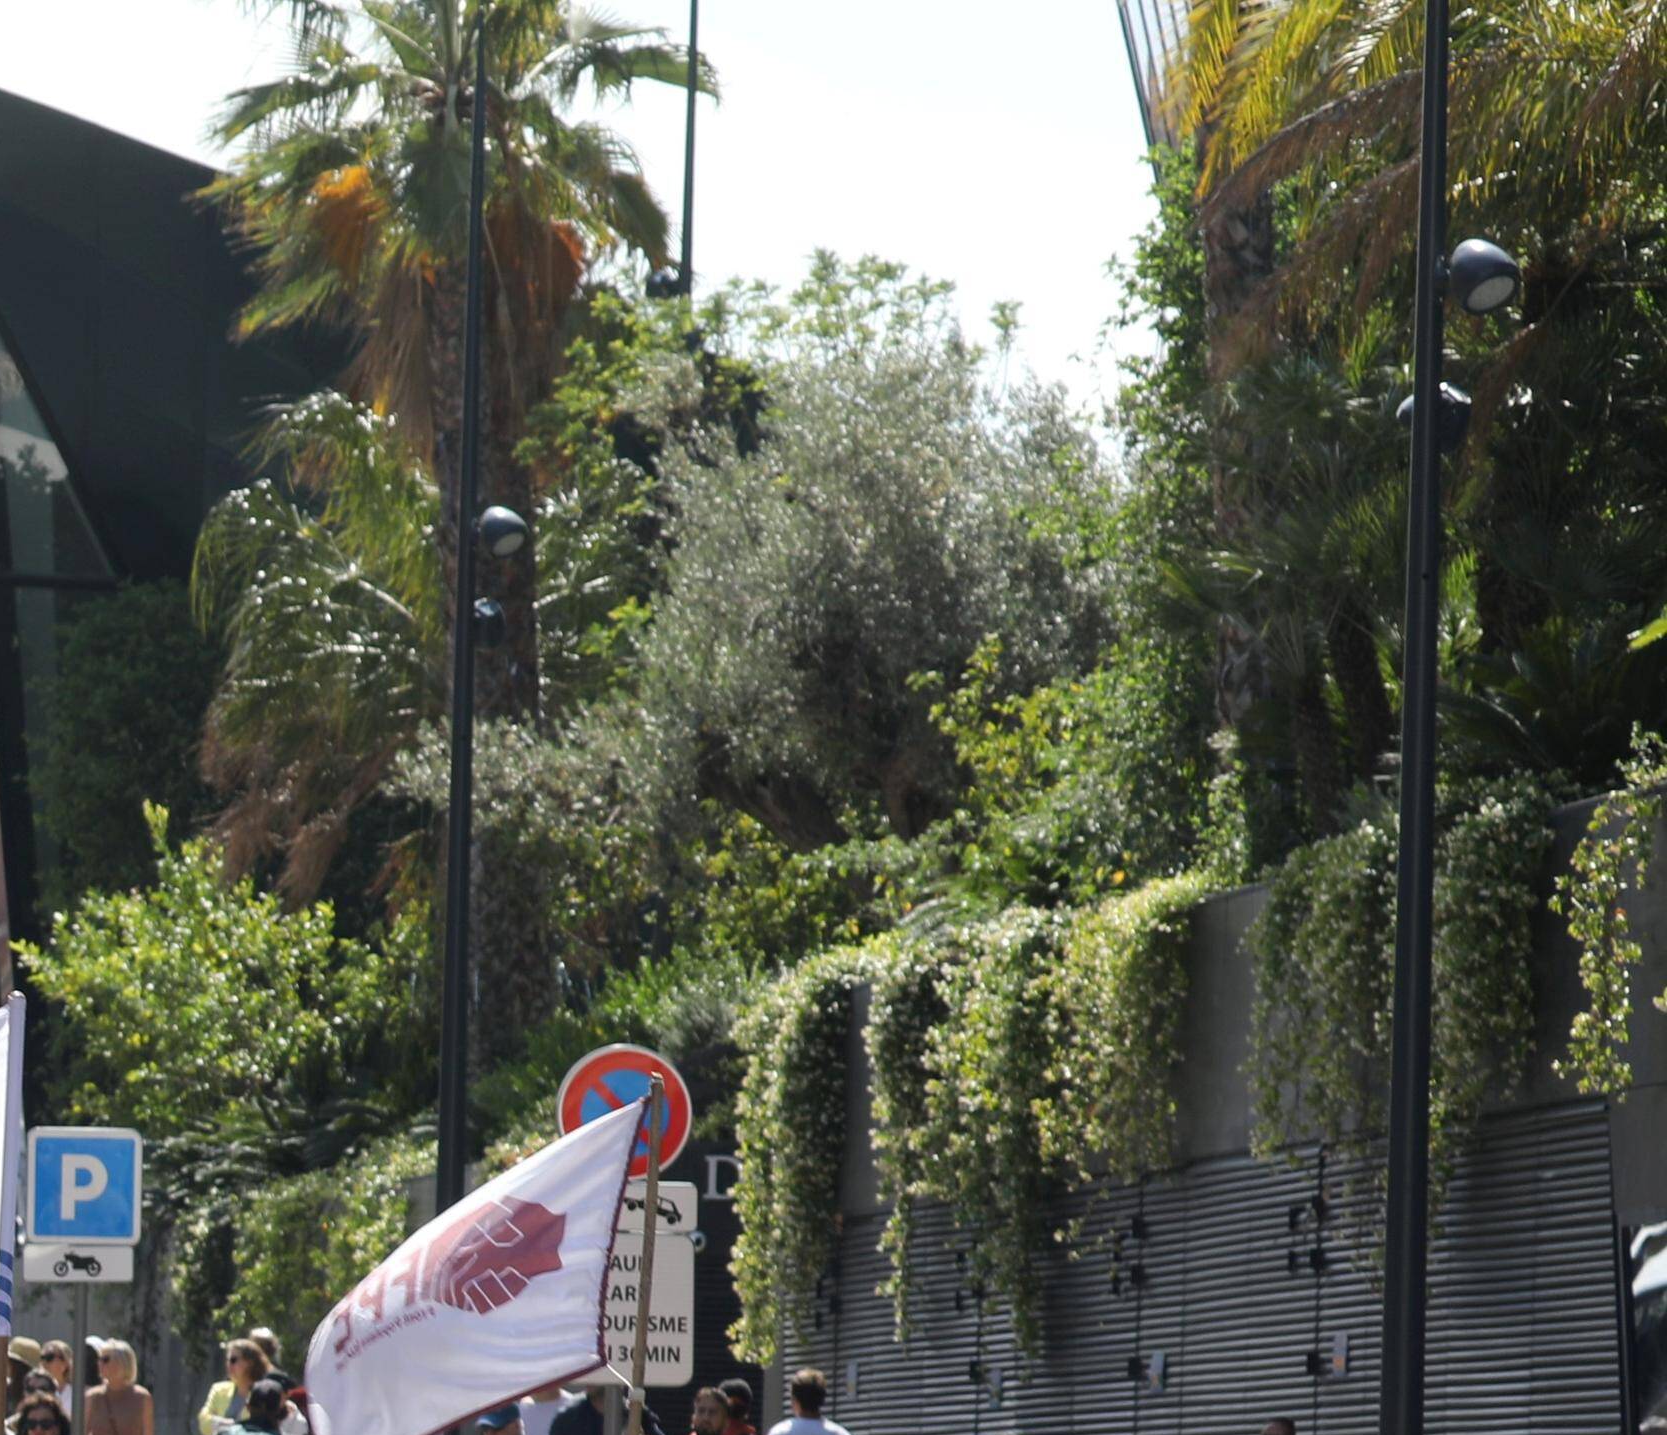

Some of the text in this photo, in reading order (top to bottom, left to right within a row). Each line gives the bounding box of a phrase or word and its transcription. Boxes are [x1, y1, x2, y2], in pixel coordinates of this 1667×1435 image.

[60, 1154, 108, 1220] P
[608, 1255, 643, 1271] AU
[602, 1316, 687, 1333] OURSME
